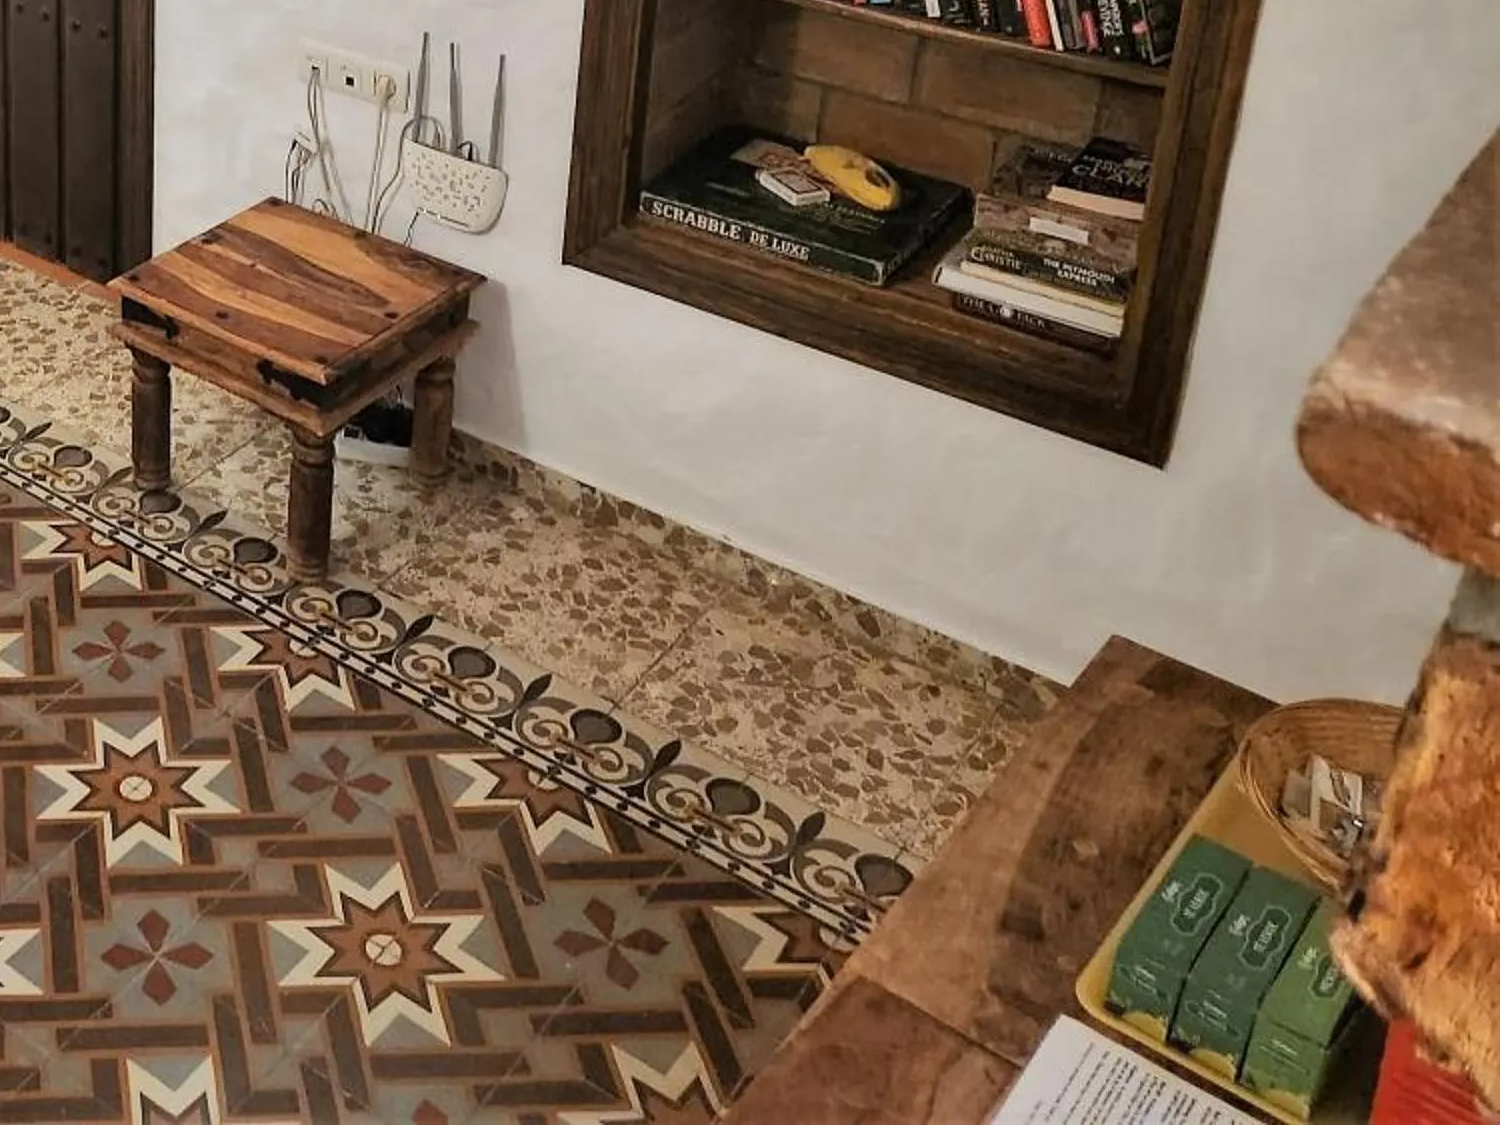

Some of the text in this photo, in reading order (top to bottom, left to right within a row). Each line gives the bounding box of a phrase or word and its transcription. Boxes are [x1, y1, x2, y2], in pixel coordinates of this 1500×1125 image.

[652, 201, 811, 261] SCRABBLE DE LUXE
